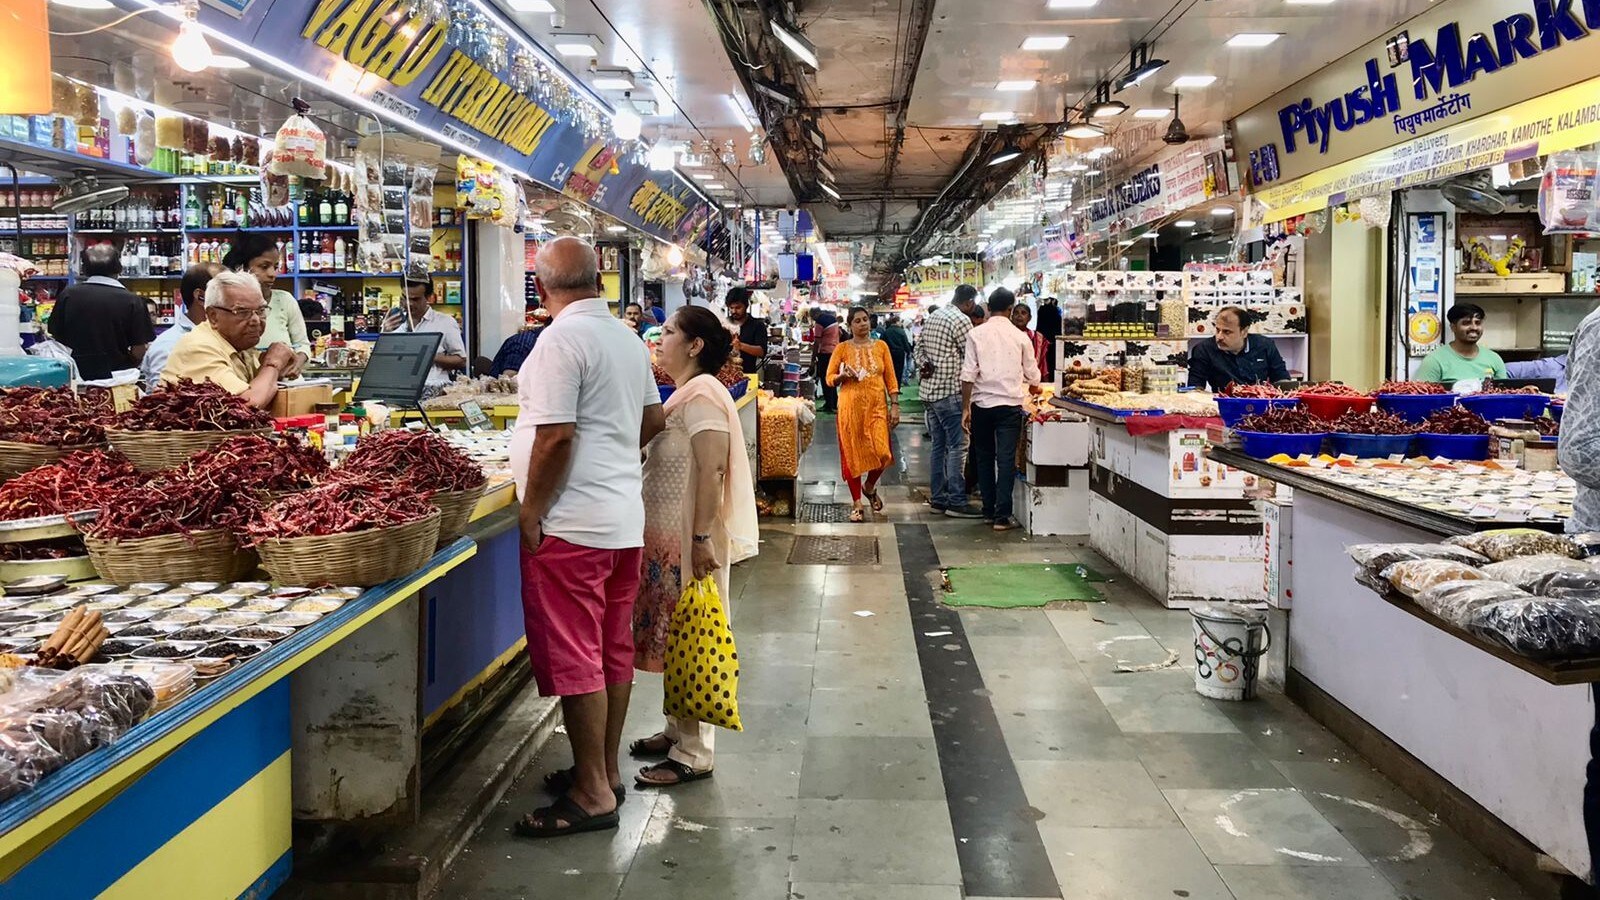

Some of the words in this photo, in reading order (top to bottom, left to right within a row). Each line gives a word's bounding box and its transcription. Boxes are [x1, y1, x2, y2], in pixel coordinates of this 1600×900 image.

[419, 49, 555, 156] INTERNATIONAL
[1278, 58, 1401, 154] Piyush
[1511, 118, 1554, 143] KAMOTHE,
[1393, 145, 1412, 160] Home
[1414, 134, 1449, 153] Delivery
